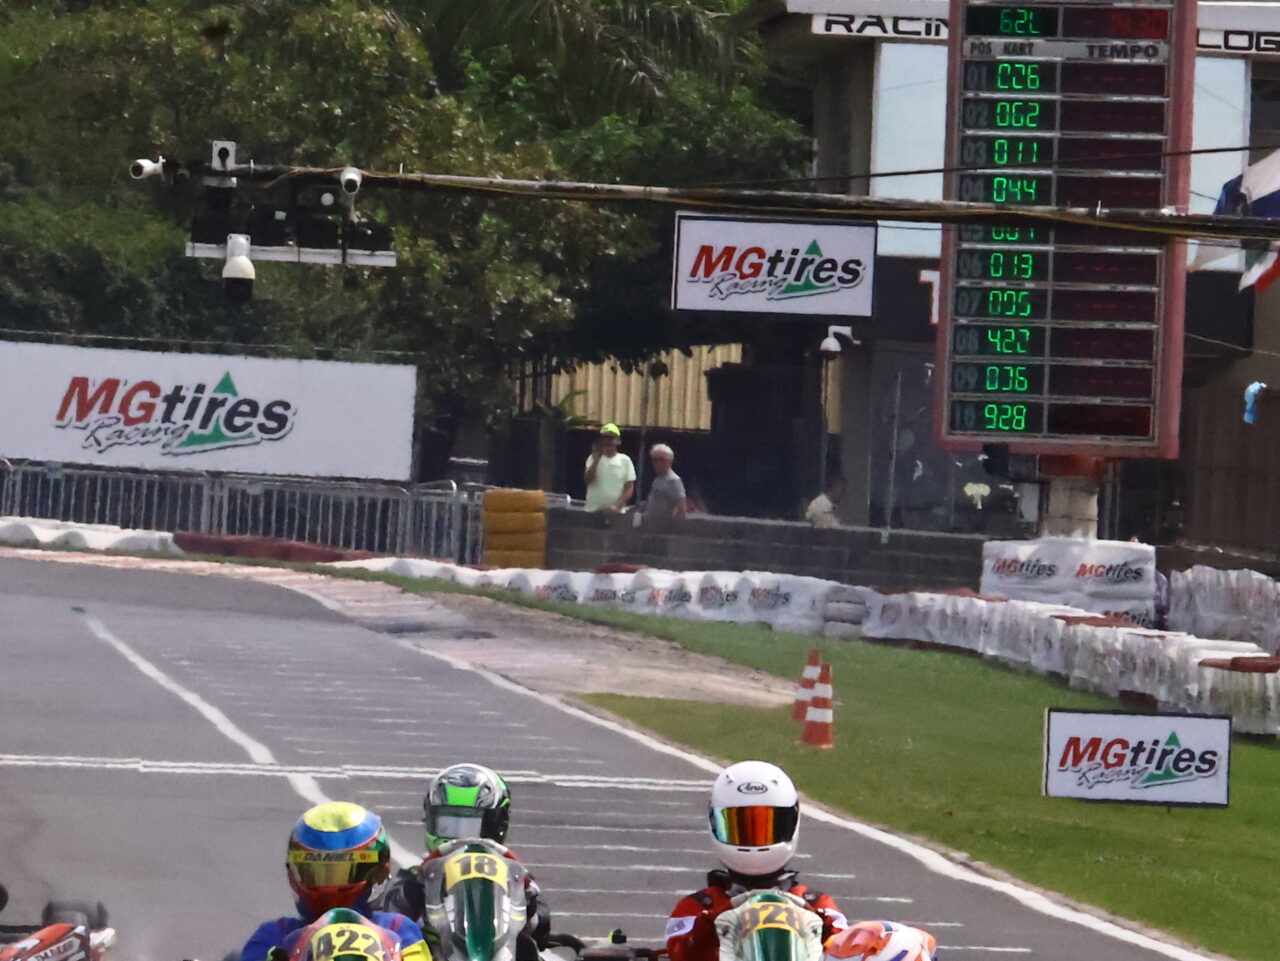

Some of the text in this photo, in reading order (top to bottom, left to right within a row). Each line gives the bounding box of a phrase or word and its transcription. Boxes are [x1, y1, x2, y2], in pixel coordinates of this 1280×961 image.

[970, 42, 1159, 59] POS KART TEMPO
[994, 139, 1038, 165] 011
[993, 177, 1037, 202] 044
[689, 244, 863, 285] MGtires
[990, 252, 1033, 278] 013
[711, 273, 788, 297] Racing
[987, 328, 1031, 353] 422
[55, 376, 292, 436] MGtires
[984, 404, 1027, 430] 928
[82, 416, 190, 450] Racing
[1074, 561, 1144, 581] MGtires
[1058, 736, 1219, 775] MGtires
[453, 855, 499, 877] 18
